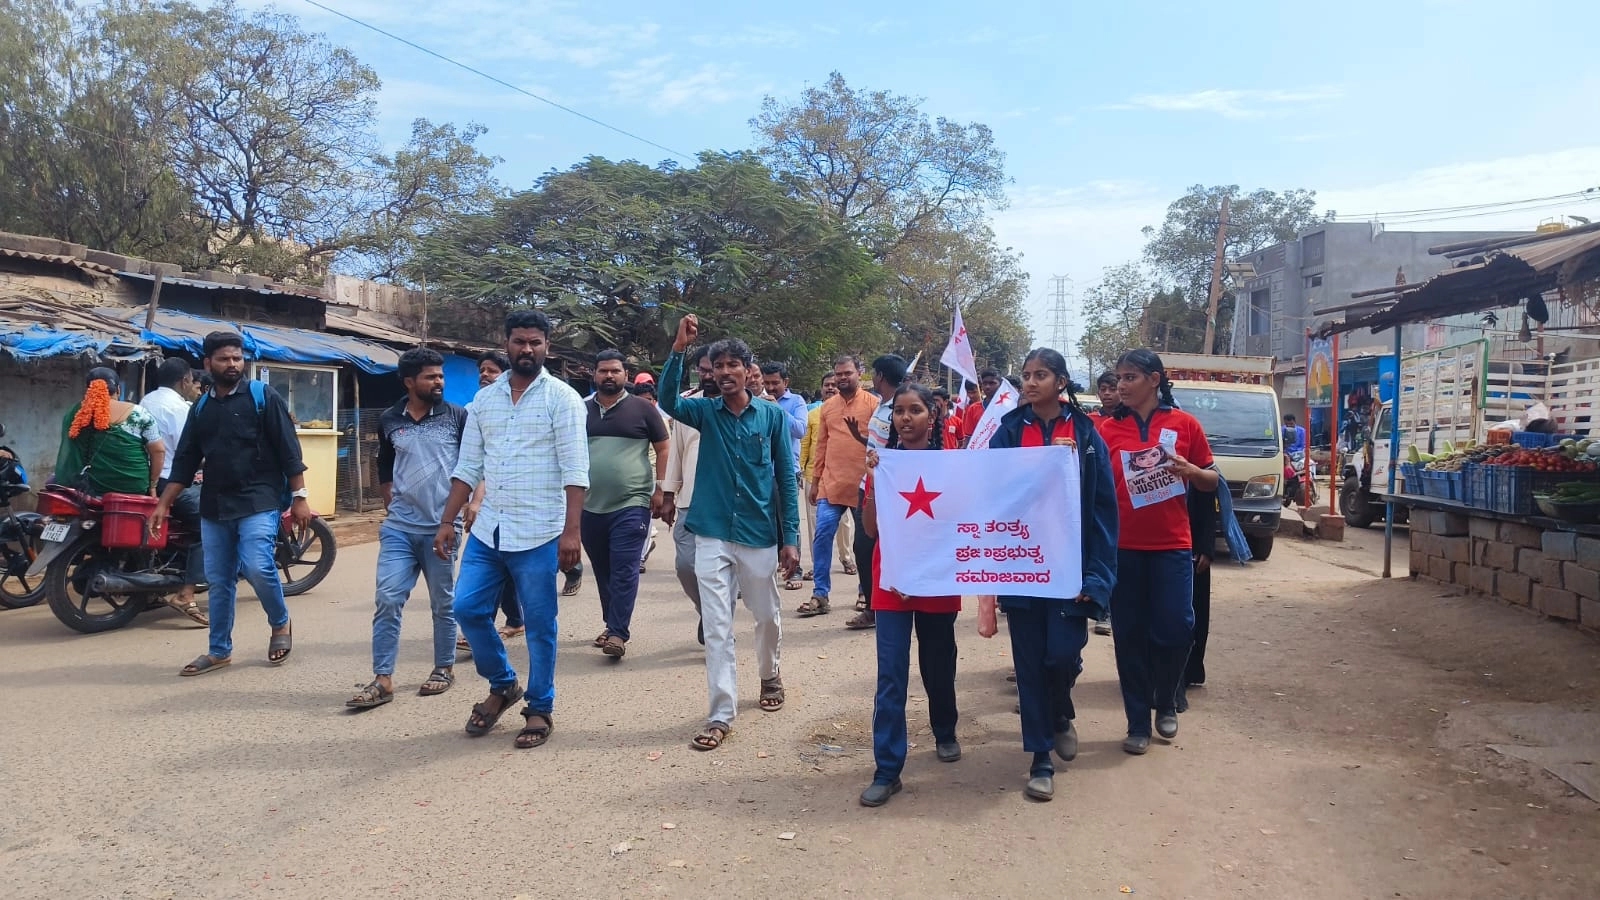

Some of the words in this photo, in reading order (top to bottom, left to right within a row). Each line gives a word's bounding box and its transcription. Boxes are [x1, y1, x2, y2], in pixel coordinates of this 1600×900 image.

[1132, 478, 1146, 486] WE
[1148, 469, 1171, 480] WAN
[1135, 475, 1176, 495] JUSTICE
[955, 569, 1051, 584] ಸಮಾಜವಾದ
